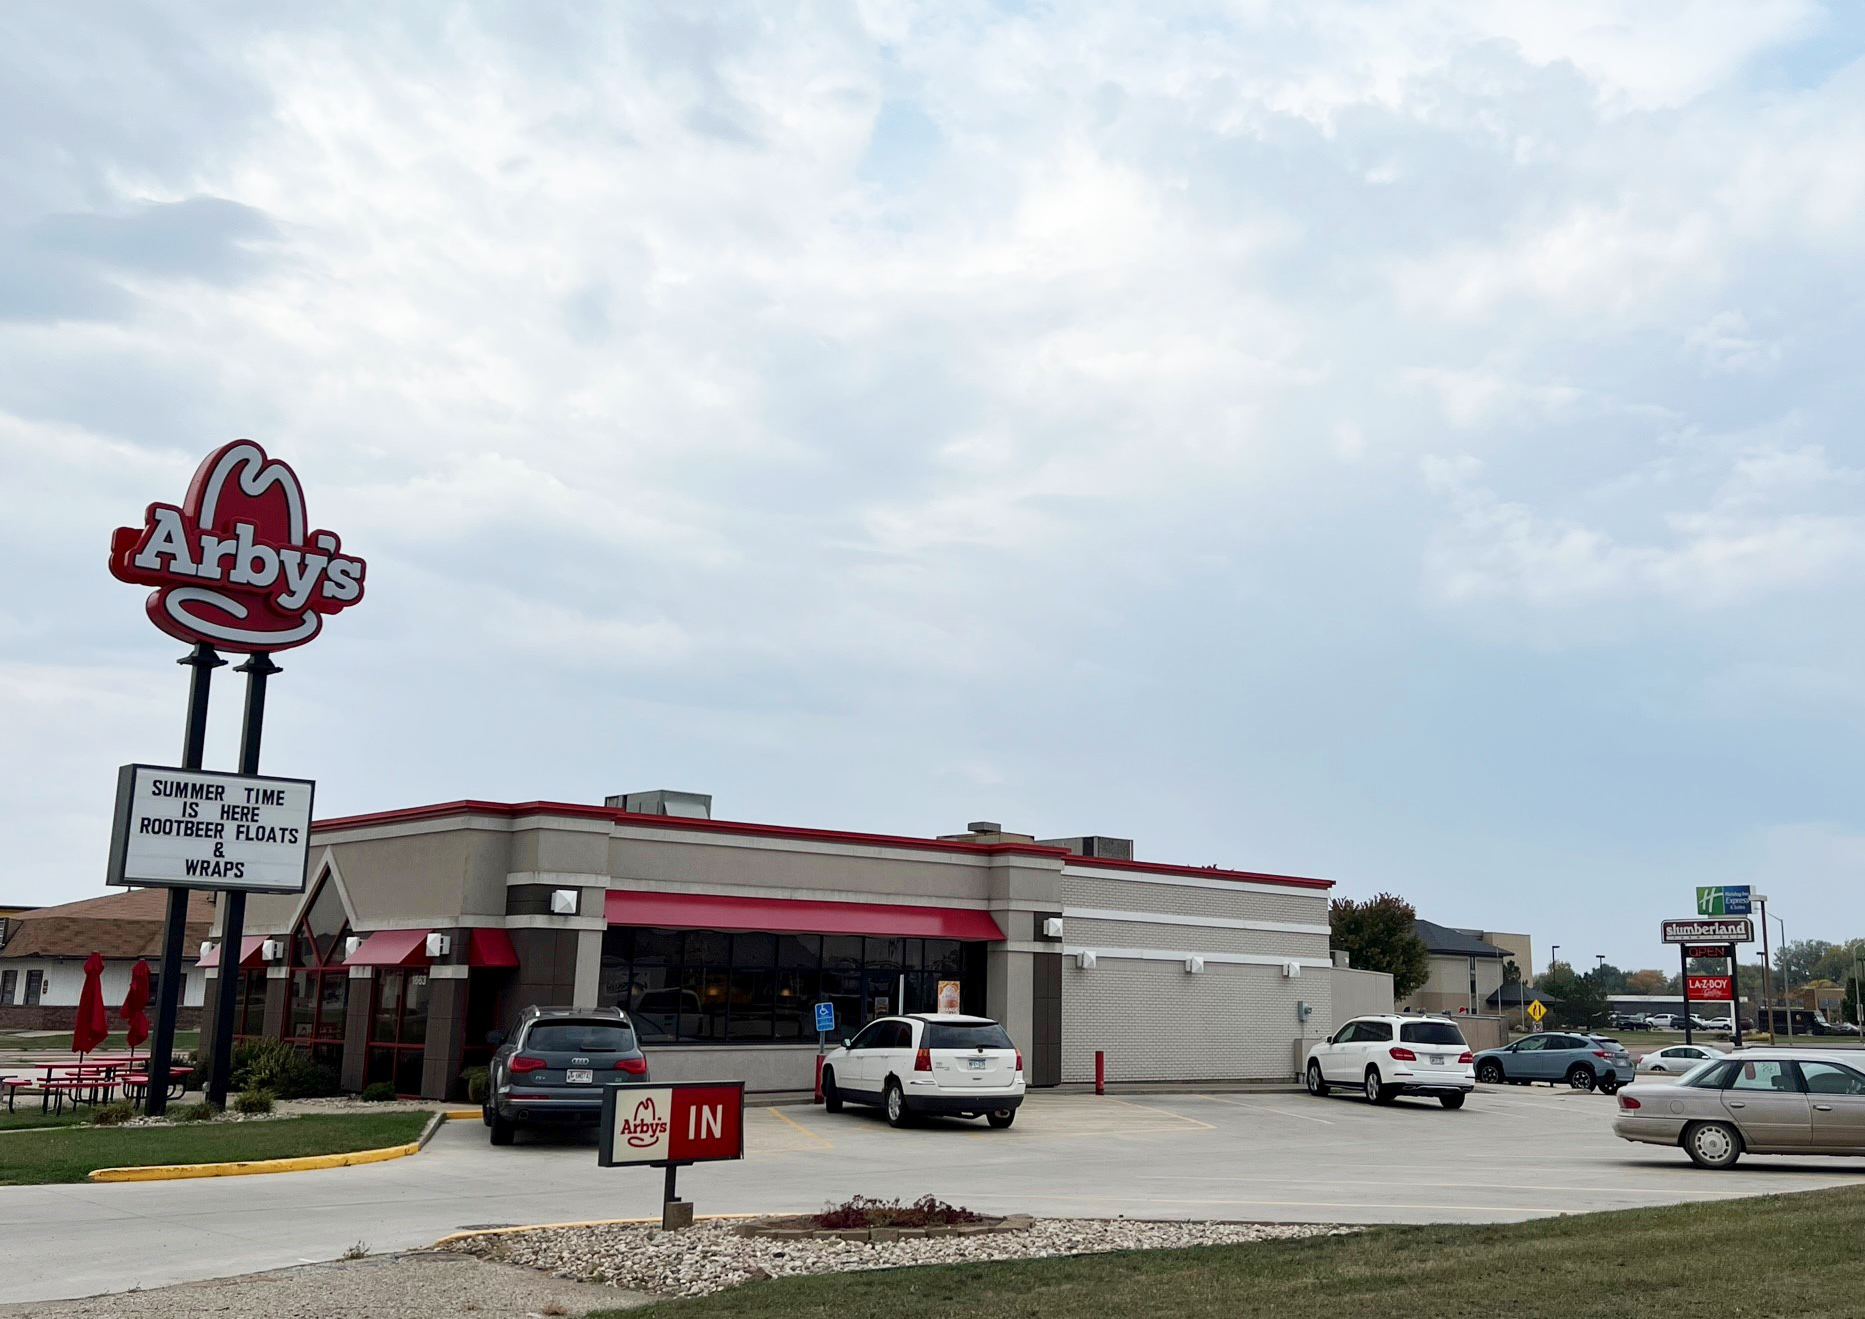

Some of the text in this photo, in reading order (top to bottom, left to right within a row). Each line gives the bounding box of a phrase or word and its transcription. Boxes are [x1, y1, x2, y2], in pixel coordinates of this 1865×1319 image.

[134, 508, 362, 610] Arby's
[151, 779, 286, 806] SUMMER TIME
[182, 801, 260, 822] IS HERE
[139, 817, 299, 844] ROOTBEER FLOATS
[213, 842, 225, 858] &
[185, 859, 245, 878] WRAPS
[1725, 896, 1750, 905] Express
[1666, 922, 1745, 935] slumberland
[1688, 946, 1725, 957] OPEN
[620, 1117, 668, 1138] Arby's
[688, 1104, 723, 1140] IN
